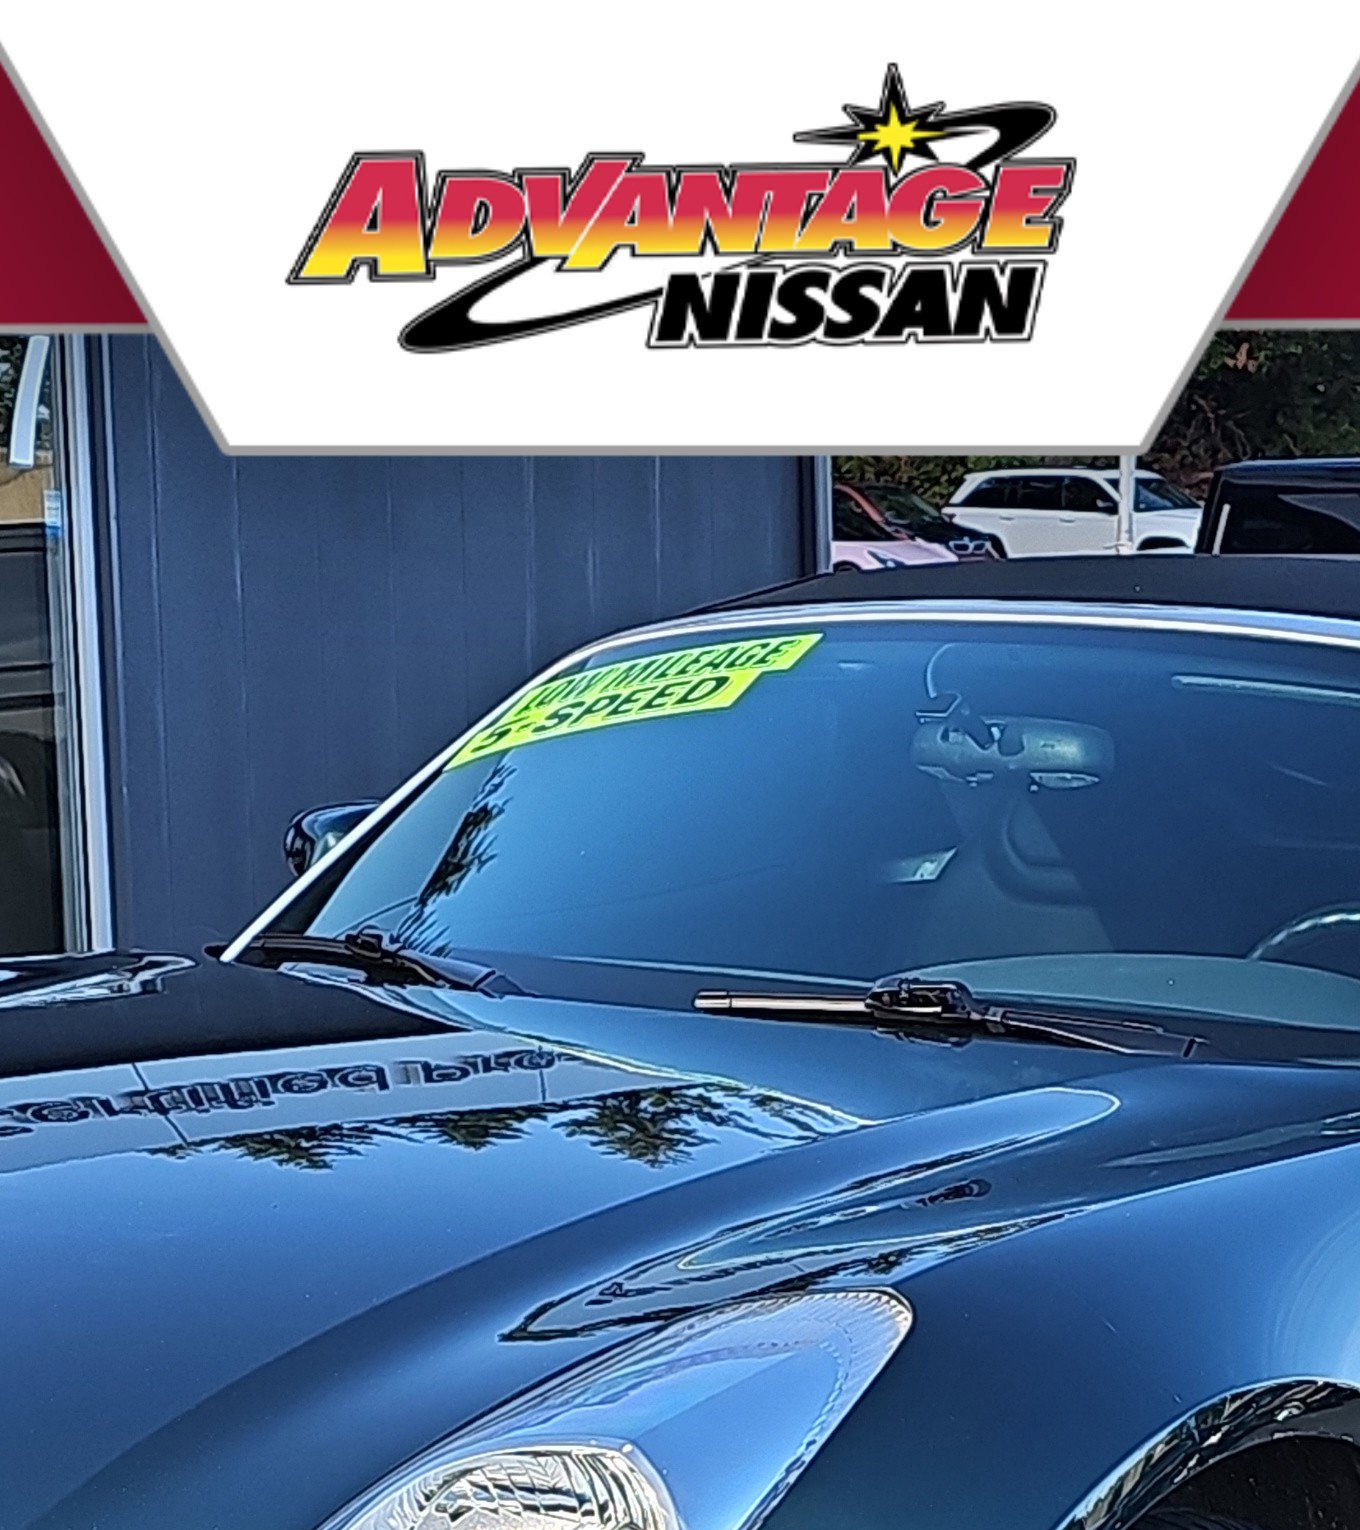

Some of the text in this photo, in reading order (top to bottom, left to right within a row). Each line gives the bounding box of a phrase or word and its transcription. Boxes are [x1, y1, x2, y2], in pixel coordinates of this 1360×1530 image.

[470, 675, 731, 753] 5-SPEED
[514, 638, 802, 718] LOW MILEAGE
